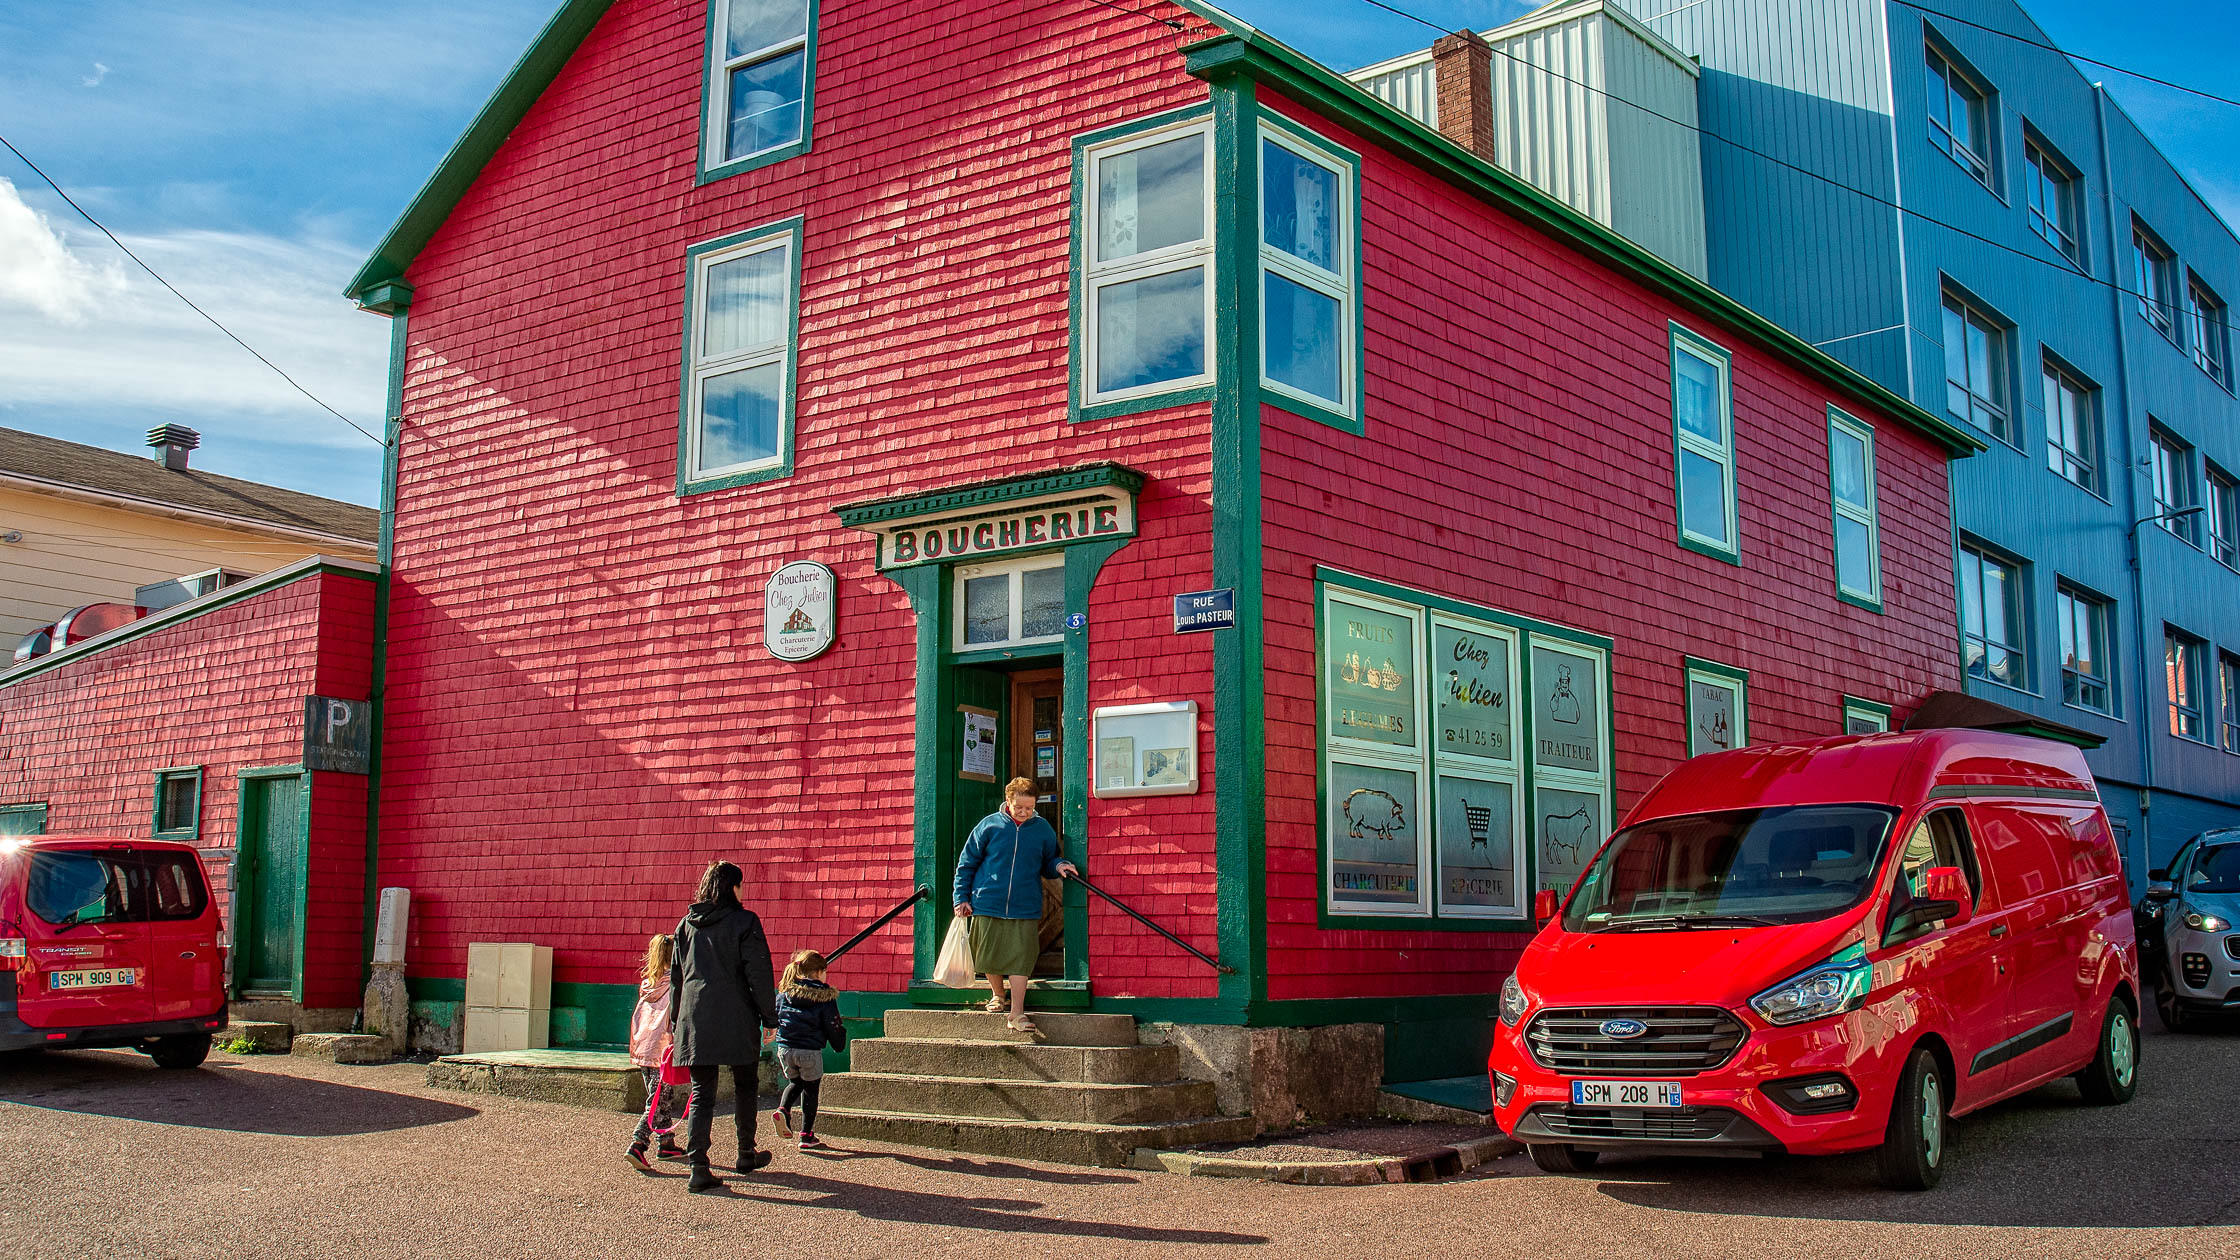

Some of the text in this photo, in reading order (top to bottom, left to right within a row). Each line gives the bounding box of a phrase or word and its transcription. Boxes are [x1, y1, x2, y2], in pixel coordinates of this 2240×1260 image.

[893, 504, 1119, 563] BOUCHERIE
[778, 569, 820, 586] Boucherie
[771, 586, 827, 610] Chez Julien
[1193, 596, 1215, 608] RUE
[1072, 616, 1080, 626] 3
[1176, 609, 1233, 626] LOUIS PASTEUR
[780, 635, 815, 644] Charcuterie
[1348, 619, 1393, 644] FRUITS
[1453, 636, 1489, 670] Chez
[1701, 687, 1723, 702] TABAC
[327, 699, 351, 743] P
[1458, 727, 1503, 748] 41 25 59
[1540, 739, 1592, 761] TRAITEUR
[1333, 872, 1415, 892] CHARCUTERIE
[1451, 878, 1503, 896] EPICERIE
[60, 970, 126, 986] SPM 909 G
[1607, 1022, 1634, 1034] Ford
[1584, 1084, 1669, 1104] SPM 208 H
